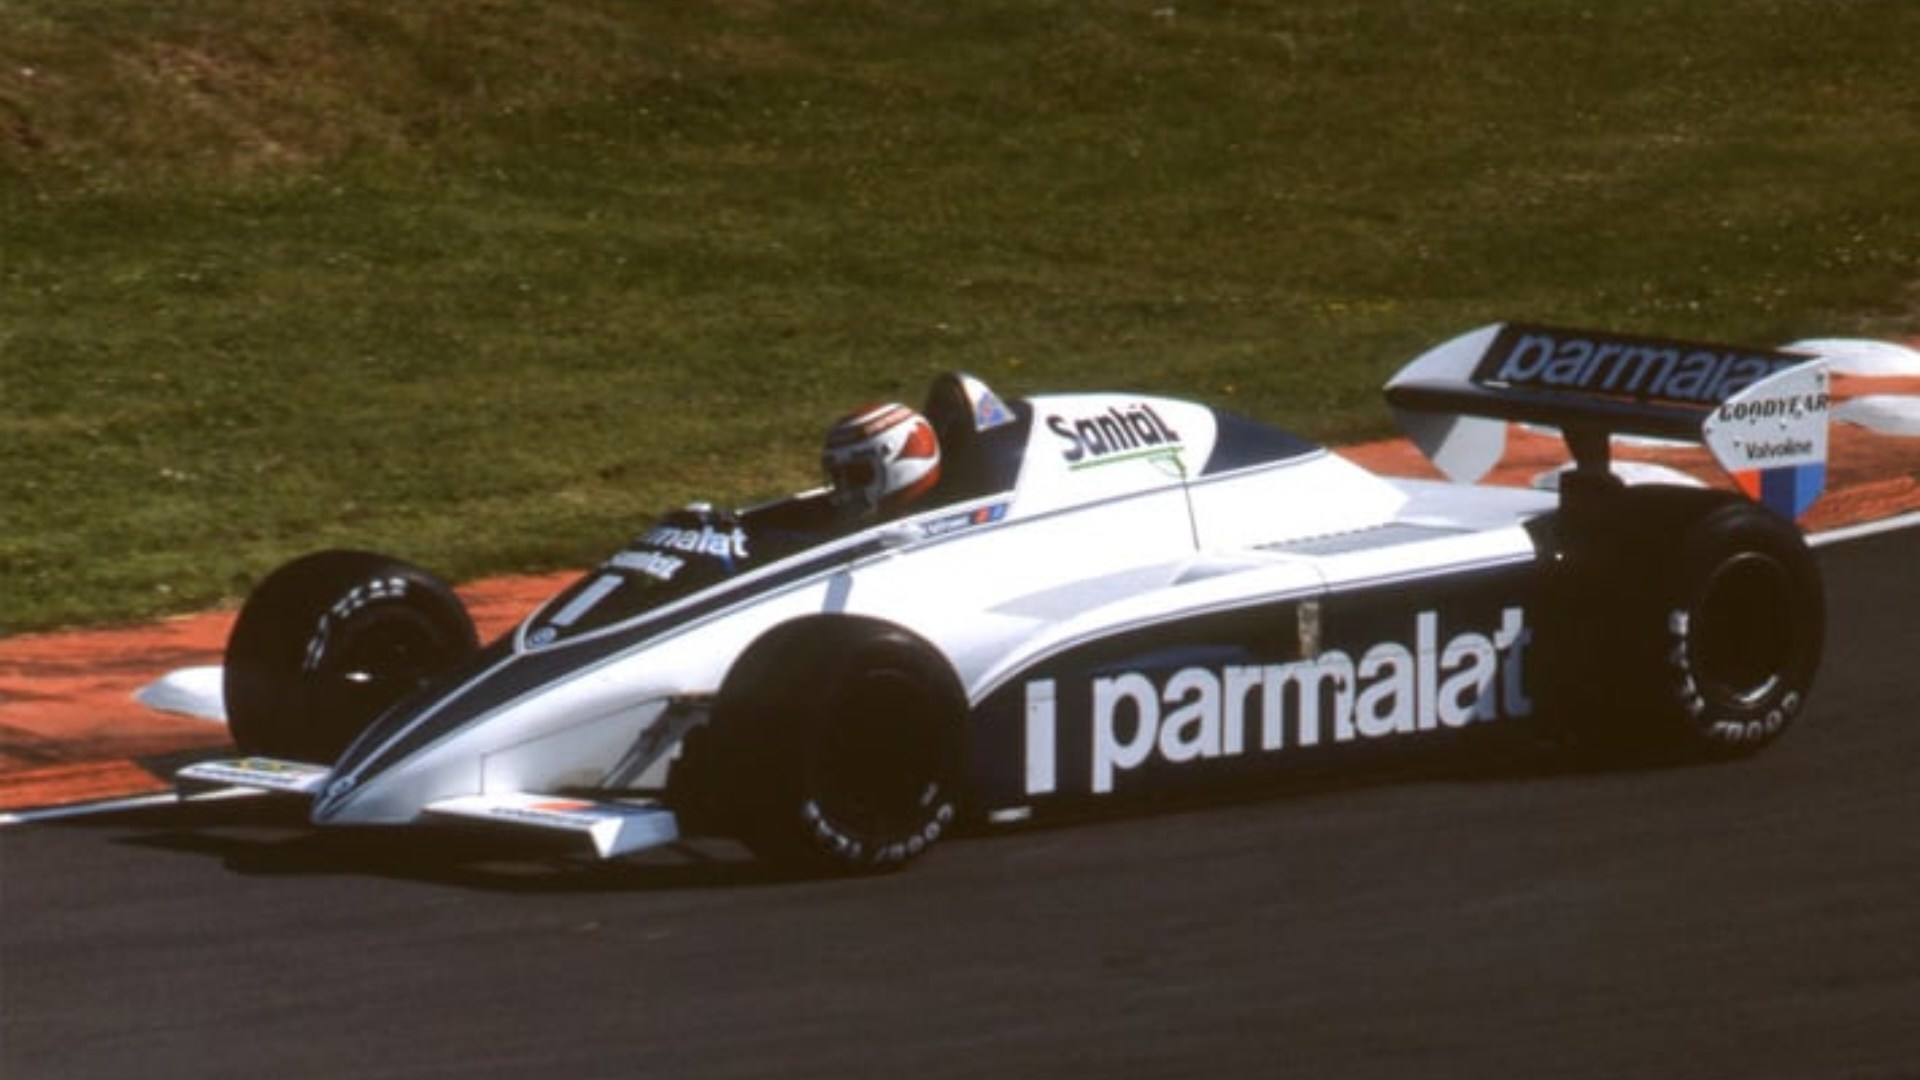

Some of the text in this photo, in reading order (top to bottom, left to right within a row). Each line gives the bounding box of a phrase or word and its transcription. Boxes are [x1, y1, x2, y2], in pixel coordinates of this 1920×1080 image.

[1500, 333, 1798, 400] parmala
[1719, 393, 1829, 422] GOODYEAR
[1744, 436, 1813, 460] Valvoline
[1092, 608, 1532, 793] parmalat
